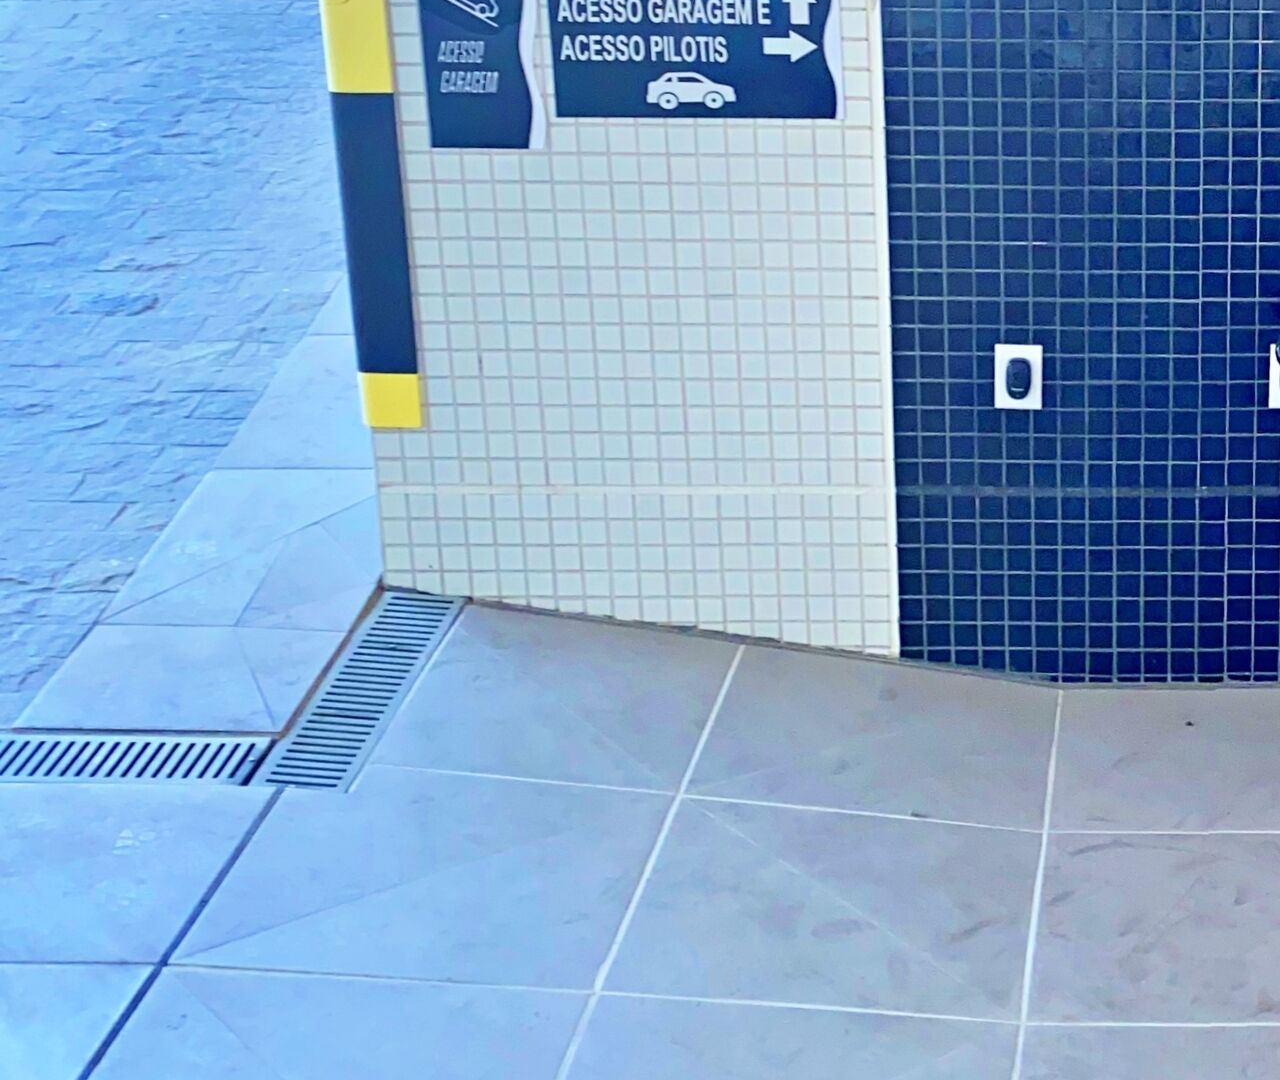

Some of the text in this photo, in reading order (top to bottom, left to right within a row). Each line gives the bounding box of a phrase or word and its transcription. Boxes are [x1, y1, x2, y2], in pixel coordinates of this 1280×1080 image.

[437, 40, 485, 64] ACESSO
[560, 34, 729, 63] ACESSO PILOTIS
[440, 70, 499, 94] GARAGEM
